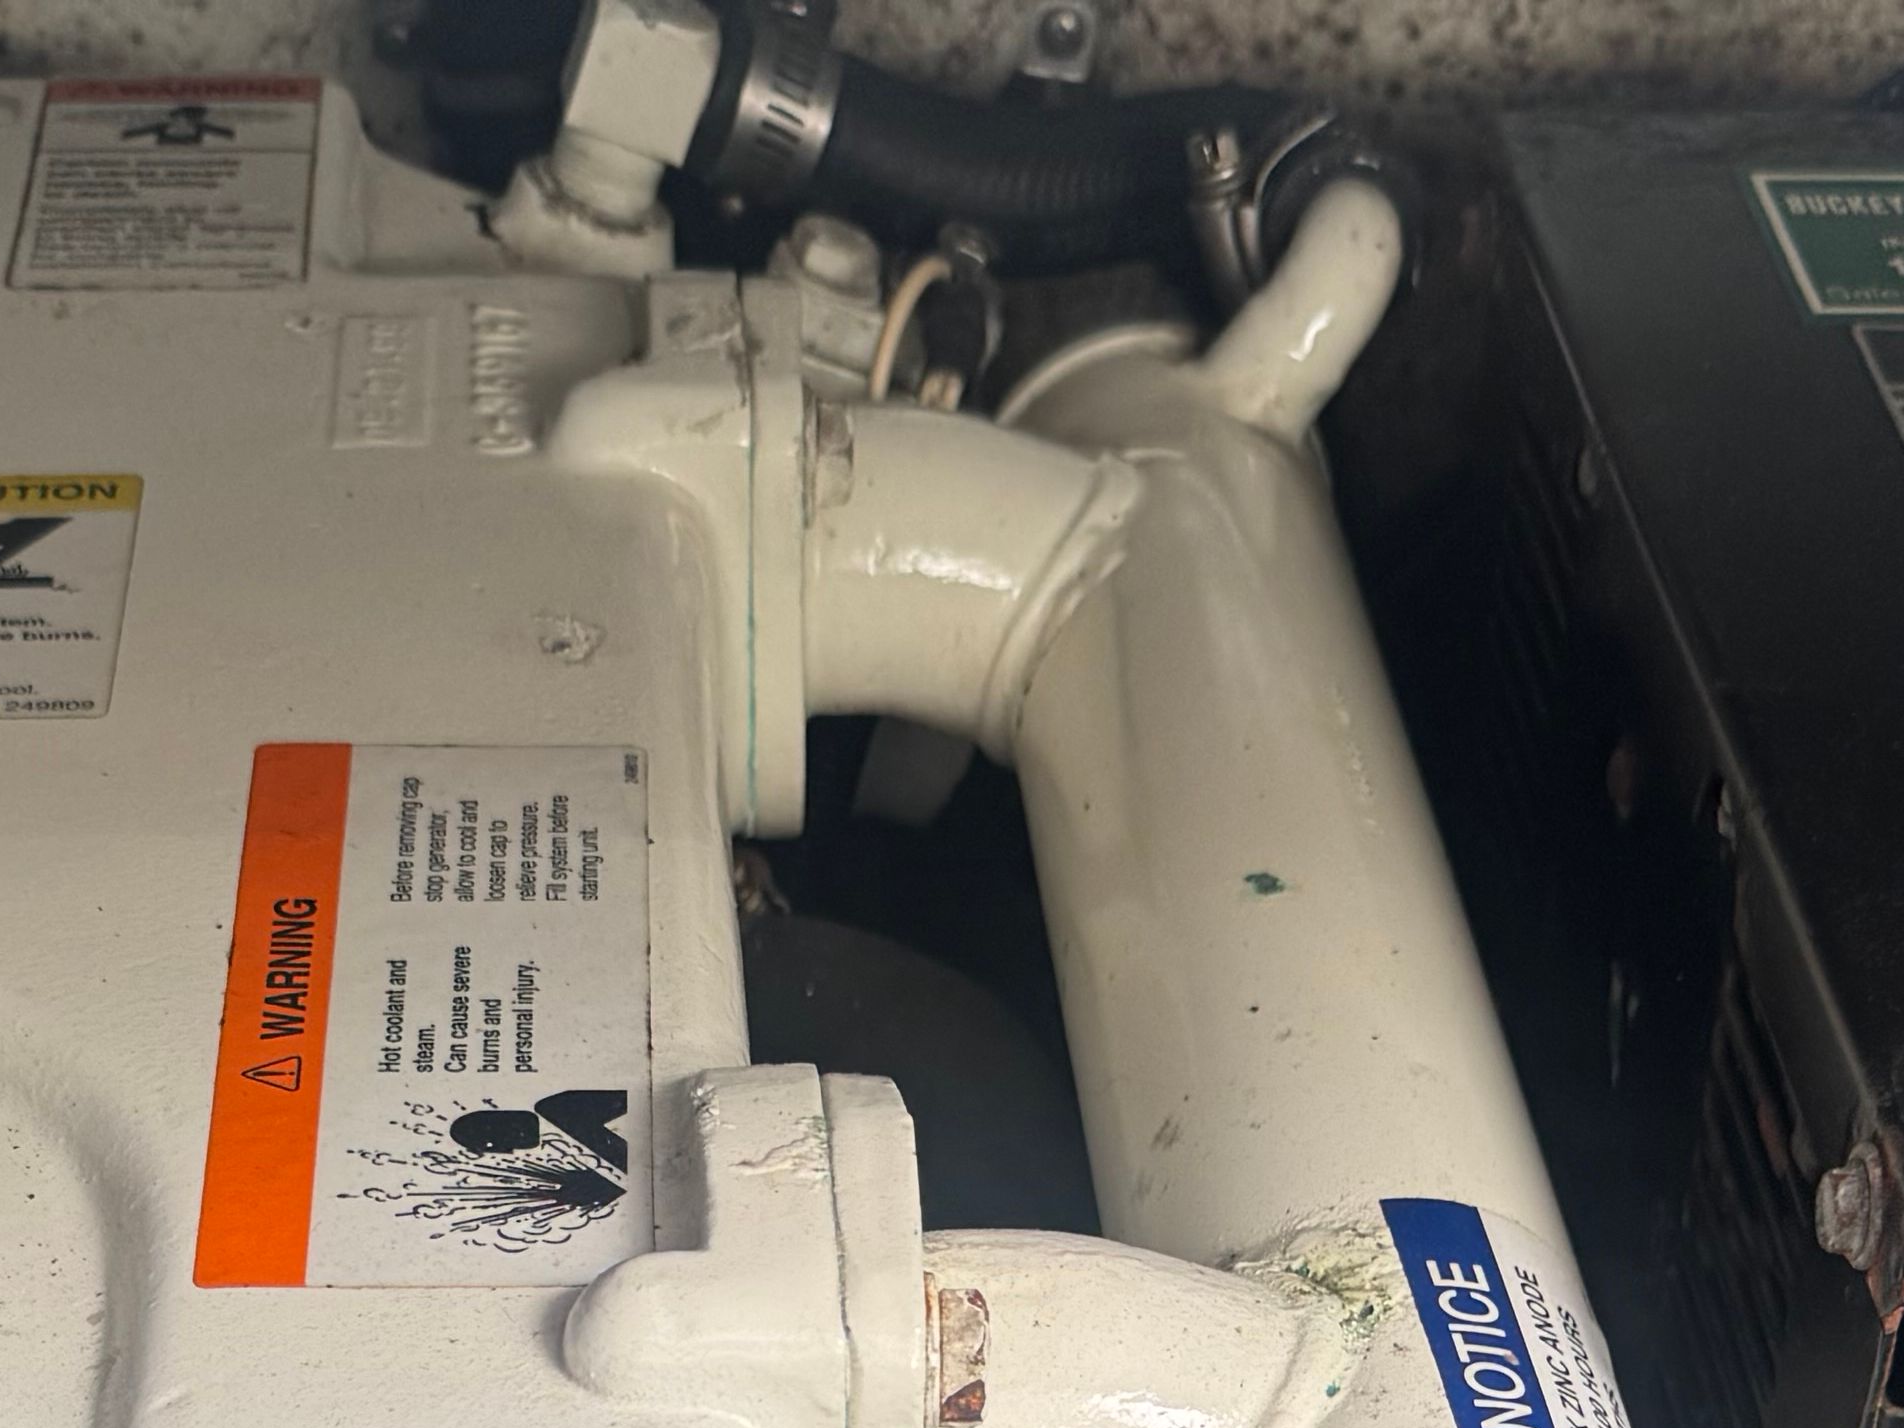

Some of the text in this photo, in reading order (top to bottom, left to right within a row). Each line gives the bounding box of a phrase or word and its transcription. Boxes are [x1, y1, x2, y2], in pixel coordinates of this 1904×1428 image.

[390, 777, 424, 902] Before removing cap
[424, 811, 450, 901] stop generator,
[454, 800, 478, 901] allow to cool and
[483, 820, 512, 902] loosen cap to
[516, 802, 543, 901] relieve pressure.
[546, 795, 573, 901] Fill system before
[578, 827, 603, 901] starting unit.
[259, 897, 318, 1041] WARNING
[377, 959, 407, 1073] Hot coolant and
[444, 946, 472, 1073] Can cause severe
[512, 960, 540, 1073] personal injury.
[412, 1024, 435, 1073] steam.
[476, 999, 502, 1072] burns and
[1514, 1265, 1564, 1356] ANODE
[1557, 1305, 1601, 1399] HOURS
[1546, 1354, 1585, 1418] ZINC
